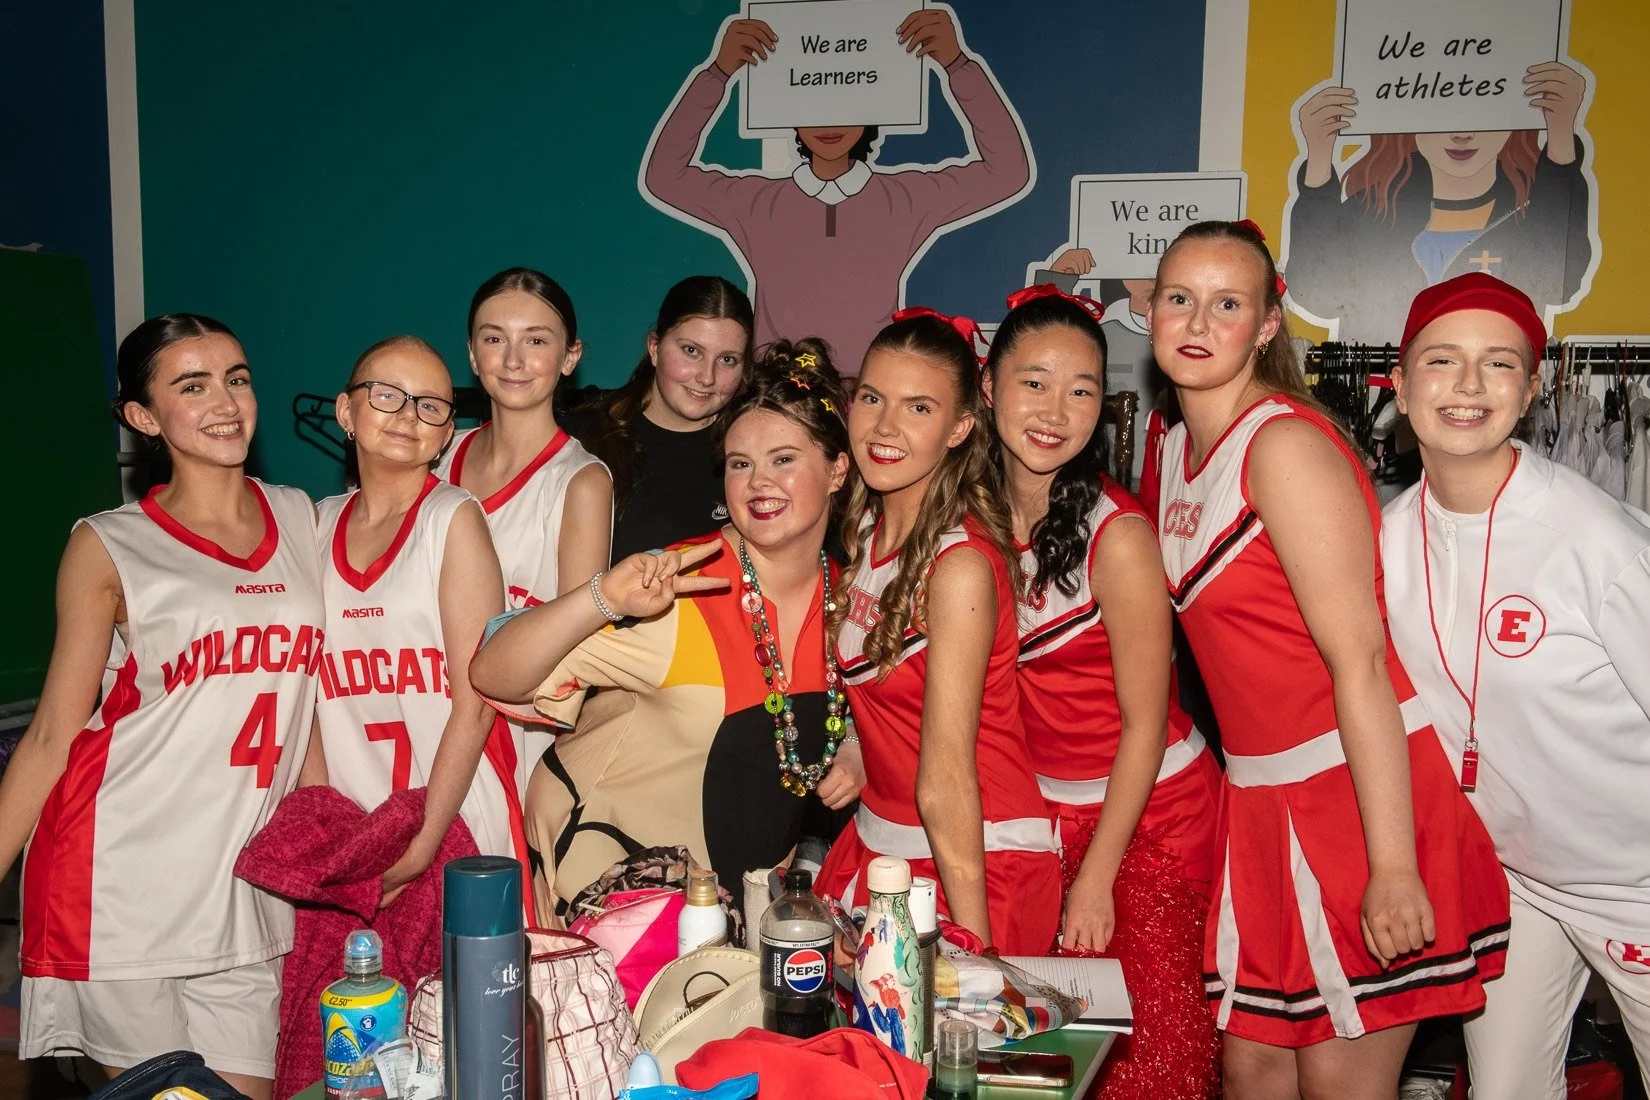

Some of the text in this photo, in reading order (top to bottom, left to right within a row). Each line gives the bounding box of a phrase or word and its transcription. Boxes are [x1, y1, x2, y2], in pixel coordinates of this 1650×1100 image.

[800, 35, 867, 54] We are
[1378, 31, 1492, 60] We are
[789, 68, 878, 87] Learners
[1376, 71, 1507, 100] athletes
[1110, 200, 1199, 222] We are
[1127, 232, 1169, 255] kin
[714, 505, 728, 516] NIK
[1497, 609, 1531, 643] E
[161, 624, 325, 695] WILDCAT
[316, 648, 453, 703] ILDCAT
[229, 692, 283, 789] 4
[363, 720, 412, 791] 7
[501, 963, 520, 984] tlc
[786, 964, 824, 976] PEPSI
